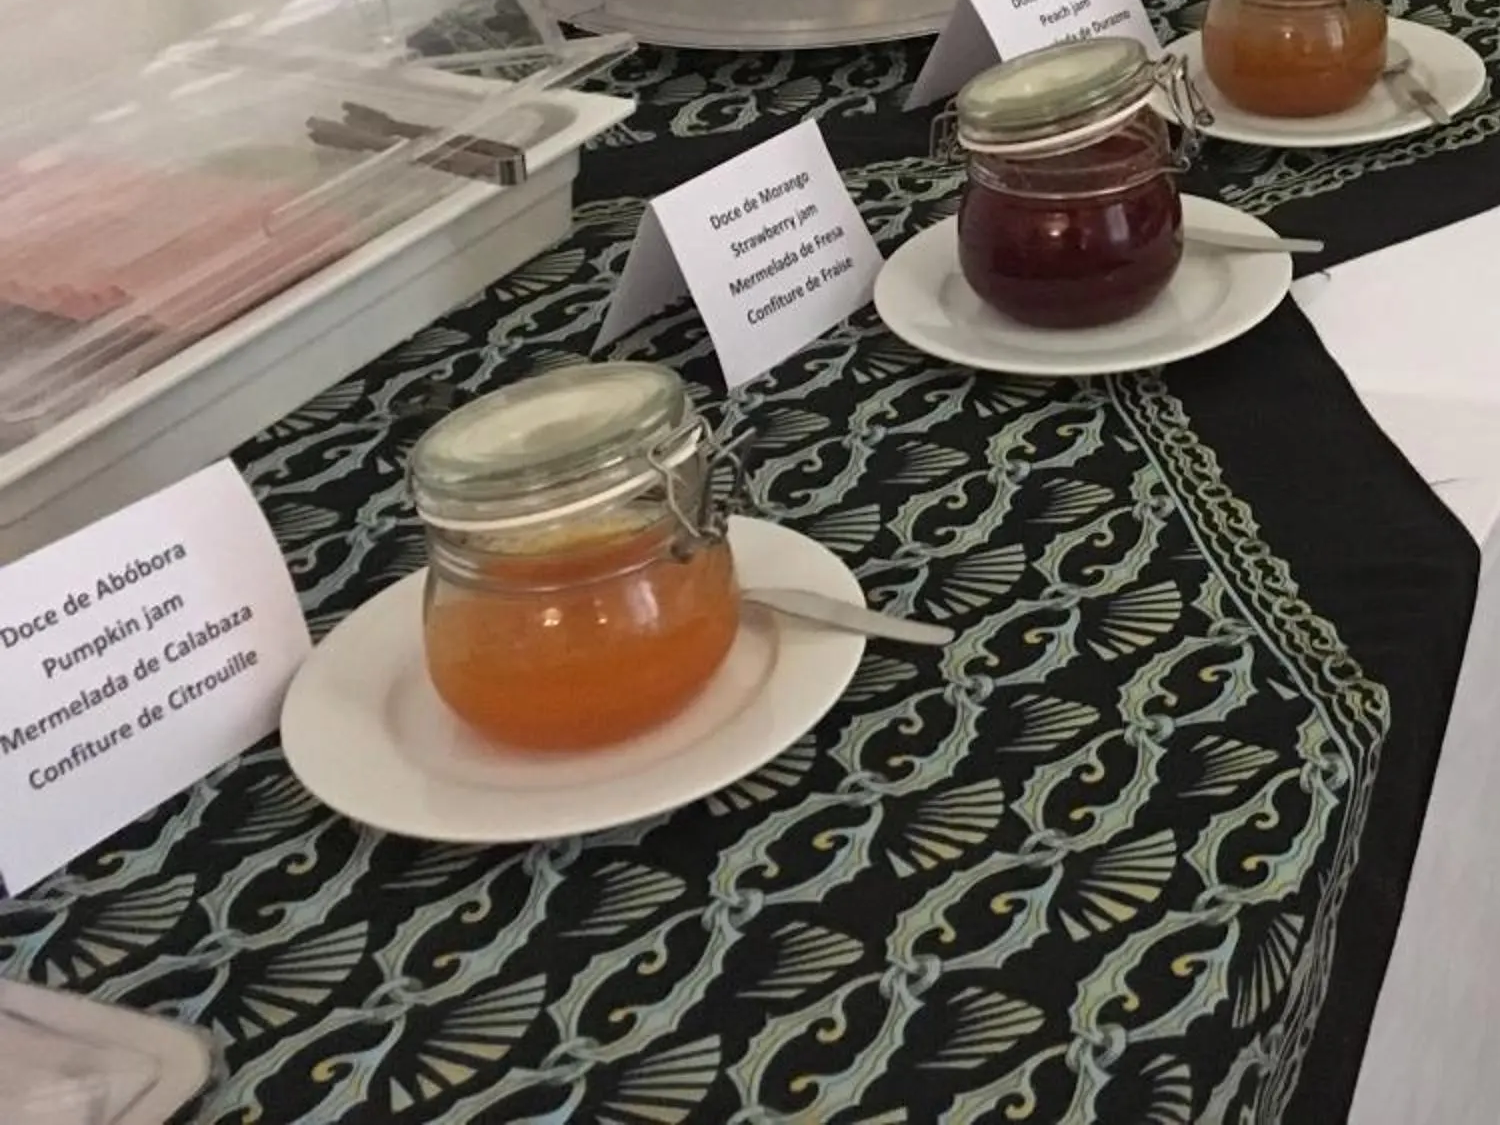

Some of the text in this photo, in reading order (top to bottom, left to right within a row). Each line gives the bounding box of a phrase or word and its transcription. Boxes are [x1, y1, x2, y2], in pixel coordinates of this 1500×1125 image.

[1039, 5, 1071, 26] Peach
[1091, 10, 1131, 32] Durazno
[709, 172, 809, 230] Doce de Morango
[730, 204, 818, 257] Strawberry jam
[729, 226, 844, 296] Mermelada de Fresa
[747, 257, 854, 324] Confiture de Fraise
[0, 543, 187, 648] Doce de Abóbora
[41, 593, 185, 678] Pumpkin jam
[0, 604, 254, 755] Mermelada de Calabaza
[28, 649, 259, 790] Confiture de Citrouille
